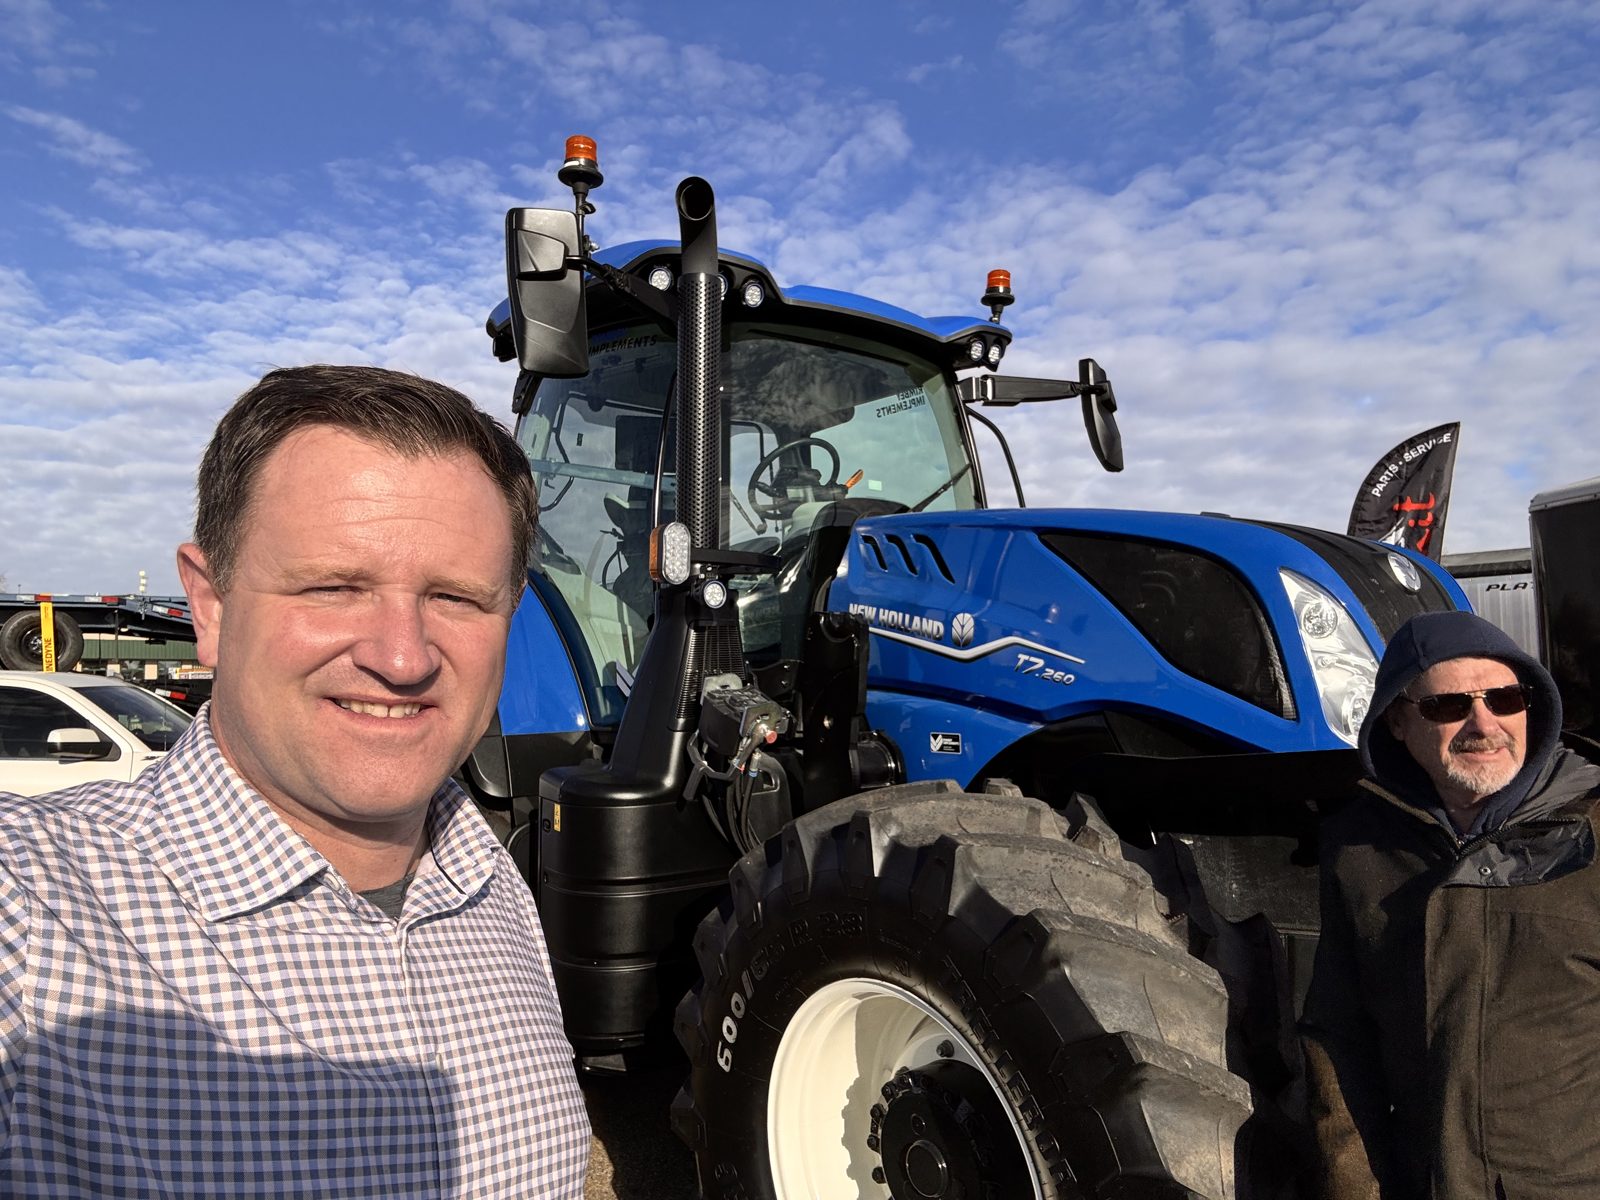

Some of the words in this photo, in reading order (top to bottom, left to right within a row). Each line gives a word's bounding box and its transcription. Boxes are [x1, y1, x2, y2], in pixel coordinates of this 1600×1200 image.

[589, 334, 658, 355] IMPLEMENTS
[1371, 463, 1399, 498] PARTS
[1485, 581, 1534, 592] PLA
[849, 603, 877, 624] NEW
[879, 608, 945, 640] HOLLAND
[1014, 653, 1075, 685] T7.260
